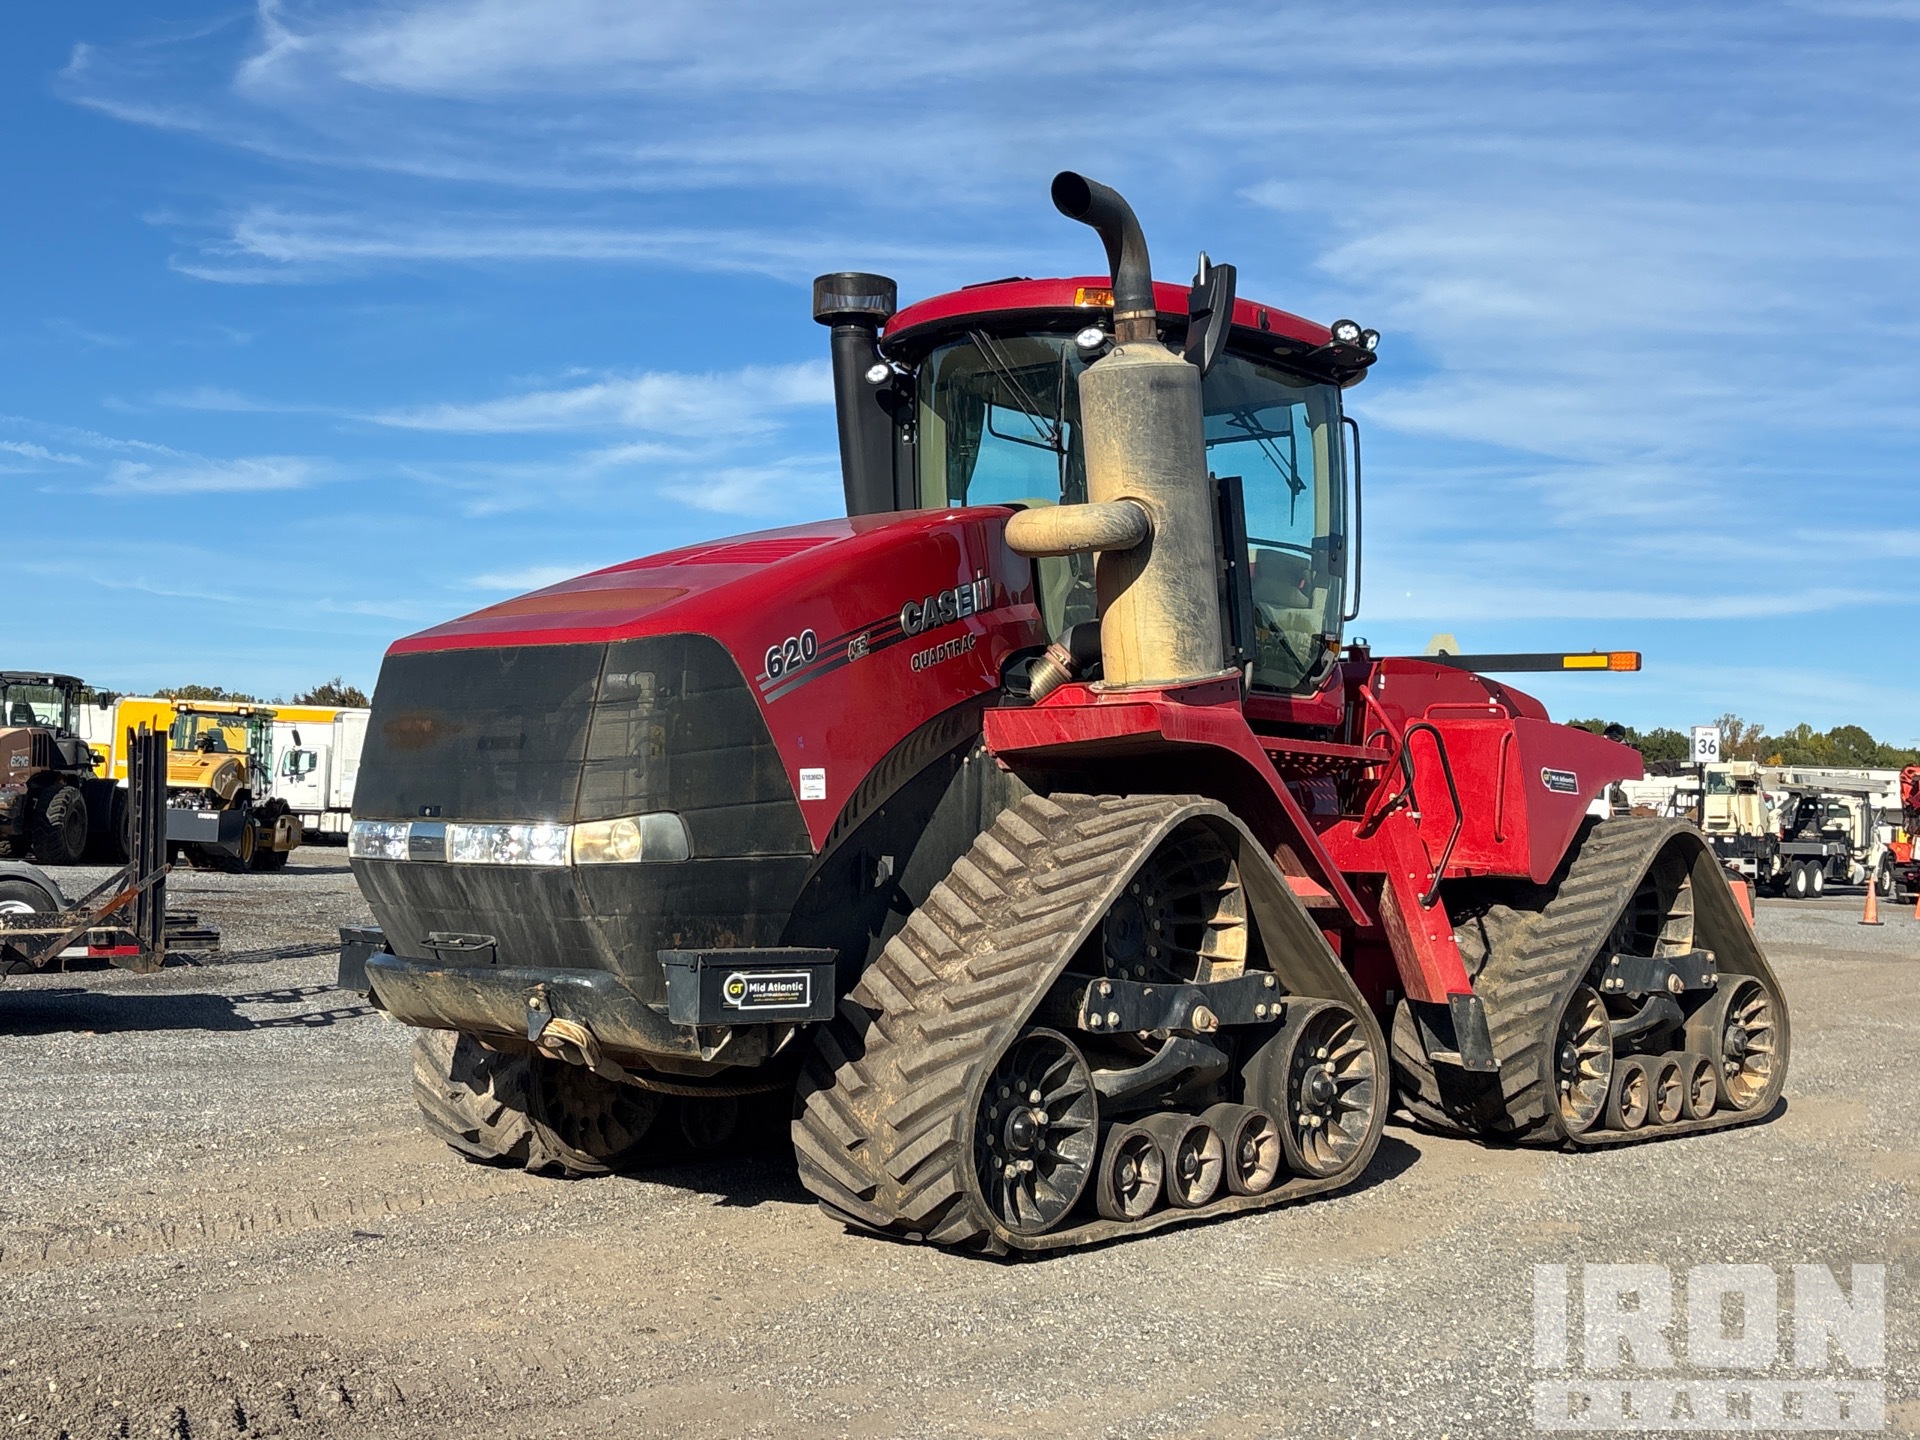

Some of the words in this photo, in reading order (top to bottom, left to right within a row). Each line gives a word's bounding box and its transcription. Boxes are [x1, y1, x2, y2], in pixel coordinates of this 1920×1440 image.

[764, 628, 818, 680] 620
[910, 632, 977, 673] QUADTRAC
[1698, 738, 1717, 755] 36
[729, 983, 743, 994] GT
[749, 982, 766, 993] Mid
[767, 981, 803, 992] Atlantic
